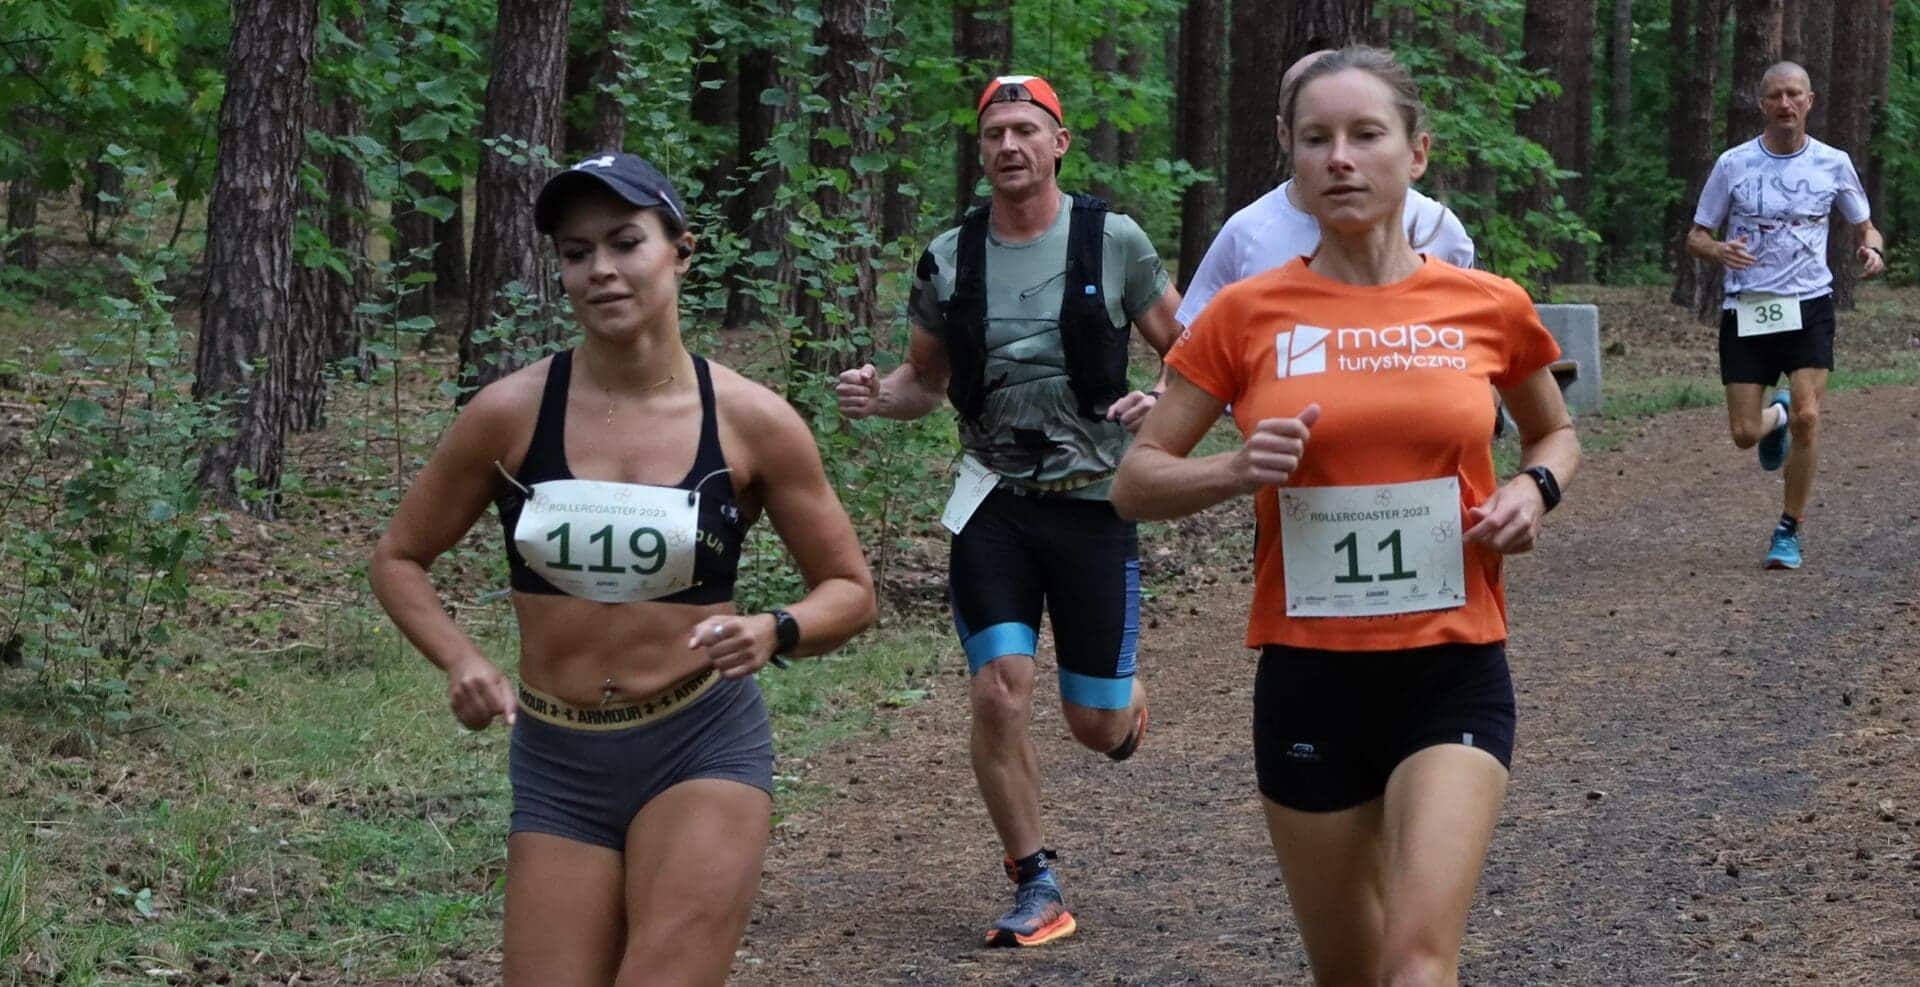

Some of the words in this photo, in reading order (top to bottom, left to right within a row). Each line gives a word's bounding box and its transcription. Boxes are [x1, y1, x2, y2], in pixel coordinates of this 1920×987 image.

[1755, 303, 1783, 325] 38
[1337, 324, 1464, 352] mapa
[1338, 352, 1466, 373] turystyczna
[549, 503, 636, 517] ROLLERCOASTER
[639, 508, 667, 518] 2023
[1310, 510, 1399, 522] ROLLERCOASTER
[1402, 506, 1431, 518] 2023
[545, 522, 667, 575] 119
[1333, 529, 1417, 583] 11
[578, 706, 643, 725] ARMOUR
